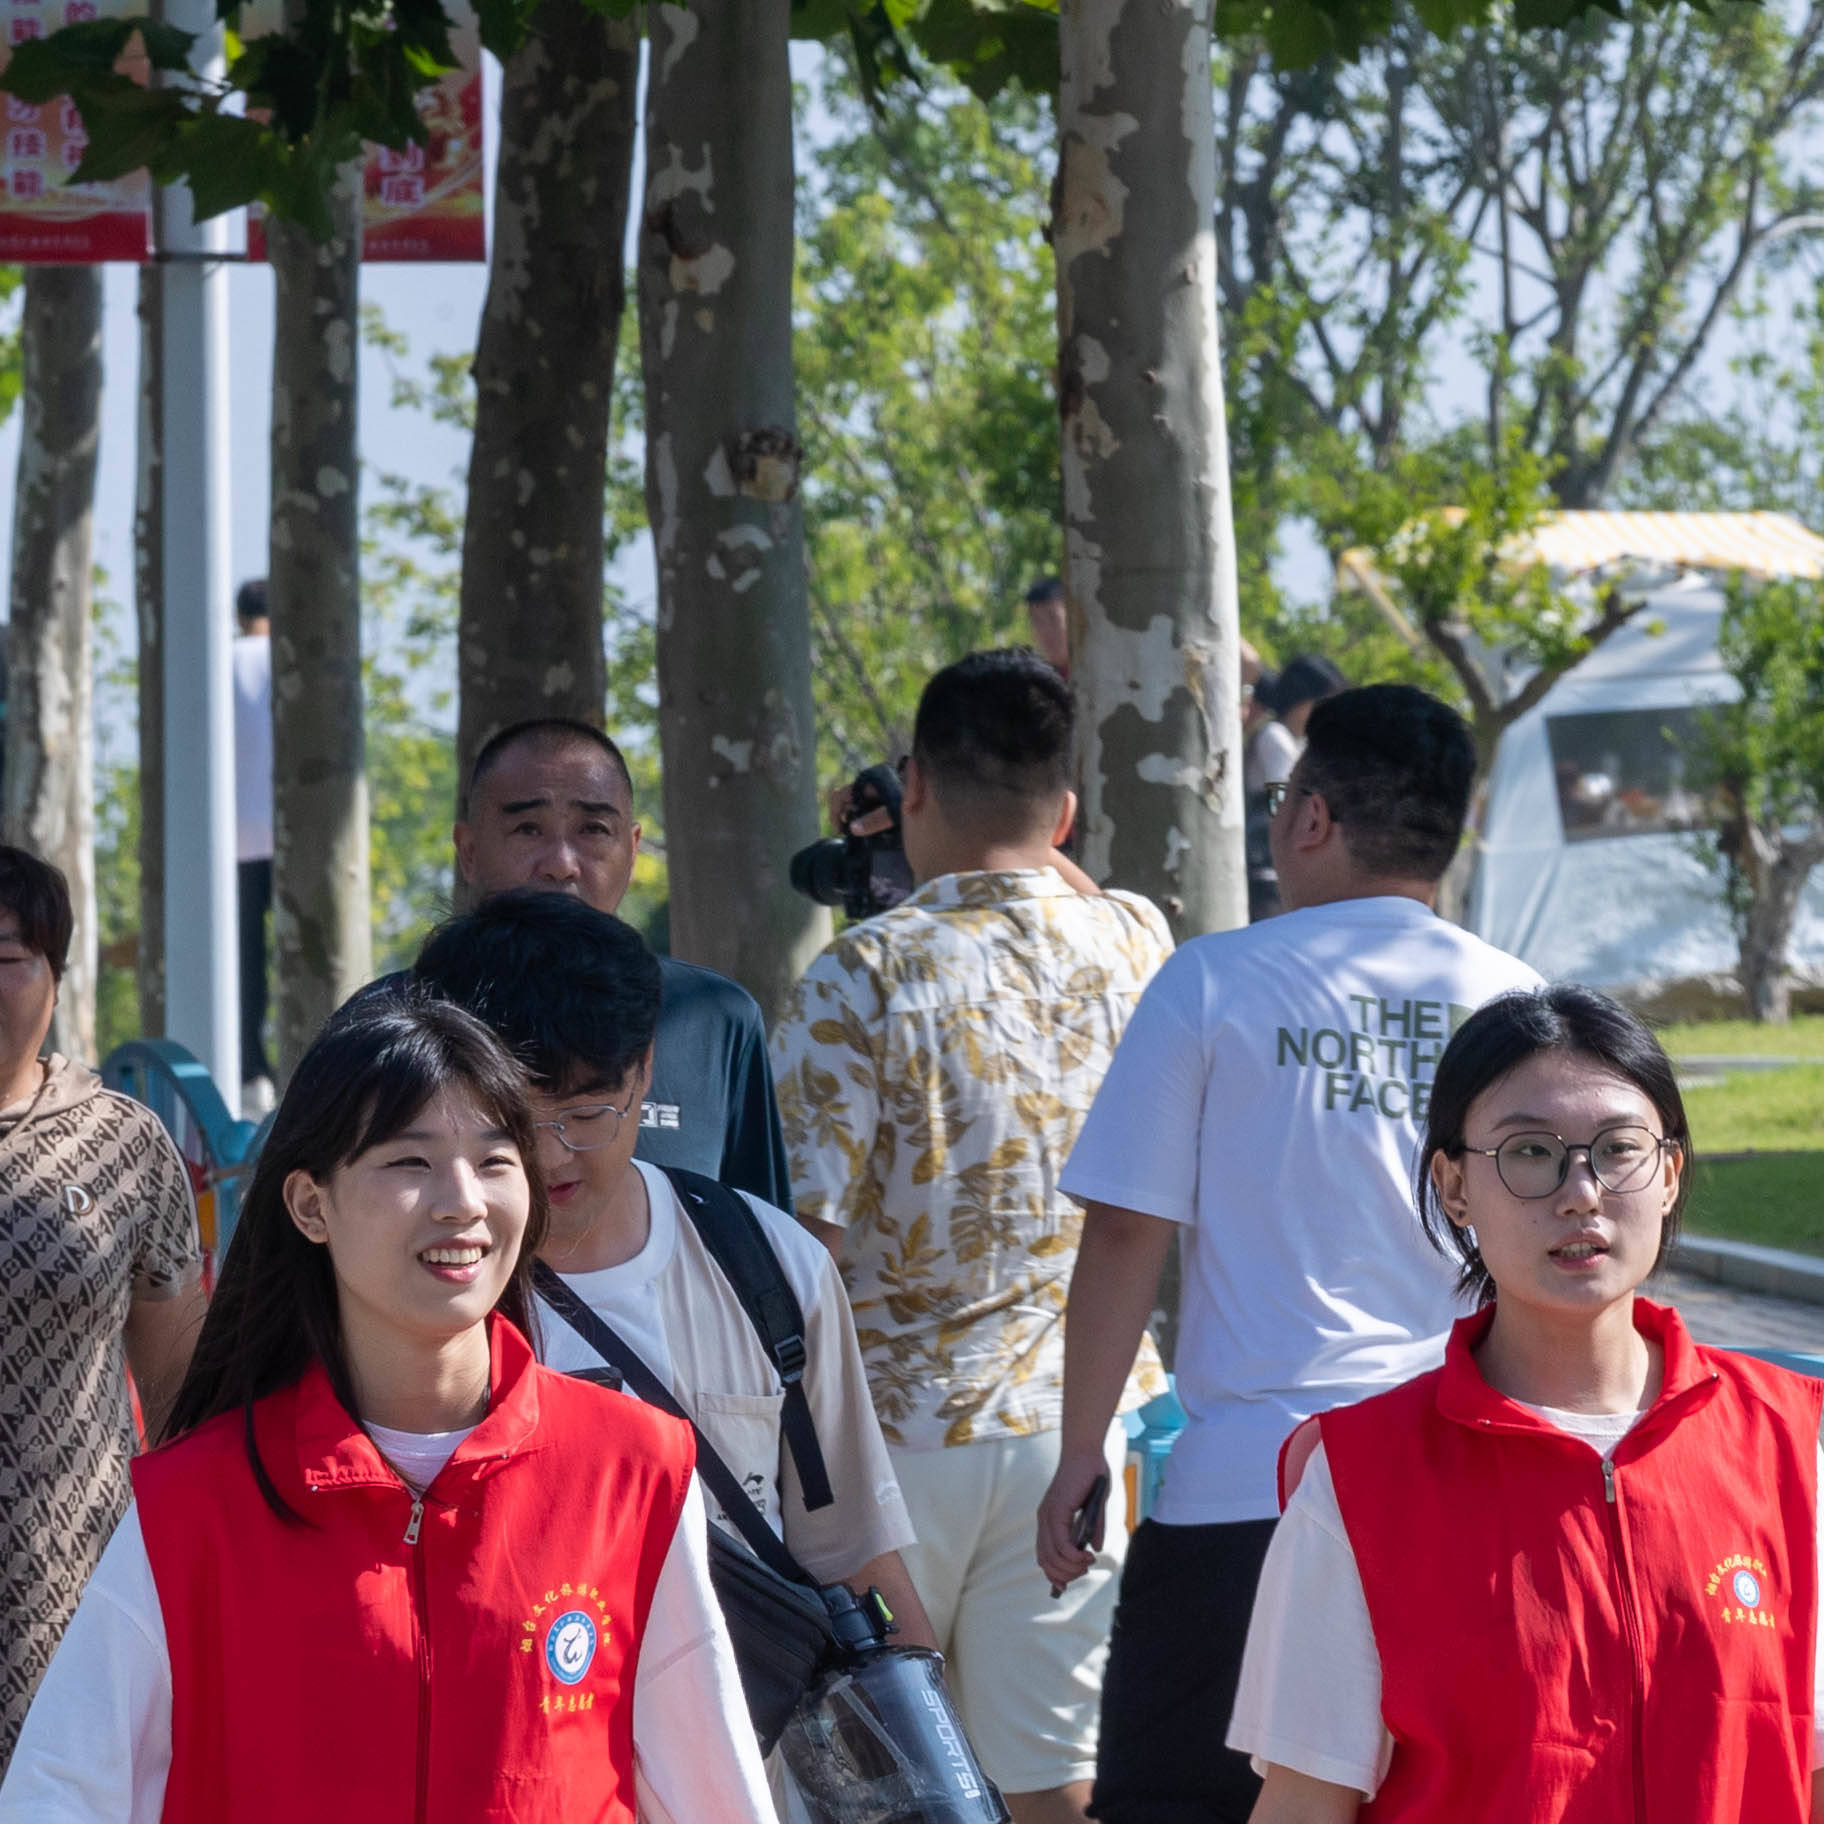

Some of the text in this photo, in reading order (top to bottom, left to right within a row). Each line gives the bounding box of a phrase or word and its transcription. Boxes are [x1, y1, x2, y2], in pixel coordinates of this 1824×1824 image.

[1349, 993, 1443, 1039] THE
[1277, 1027, 1442, 1080] NORTH
[1325, 1073, 1432, 1121] FACE
